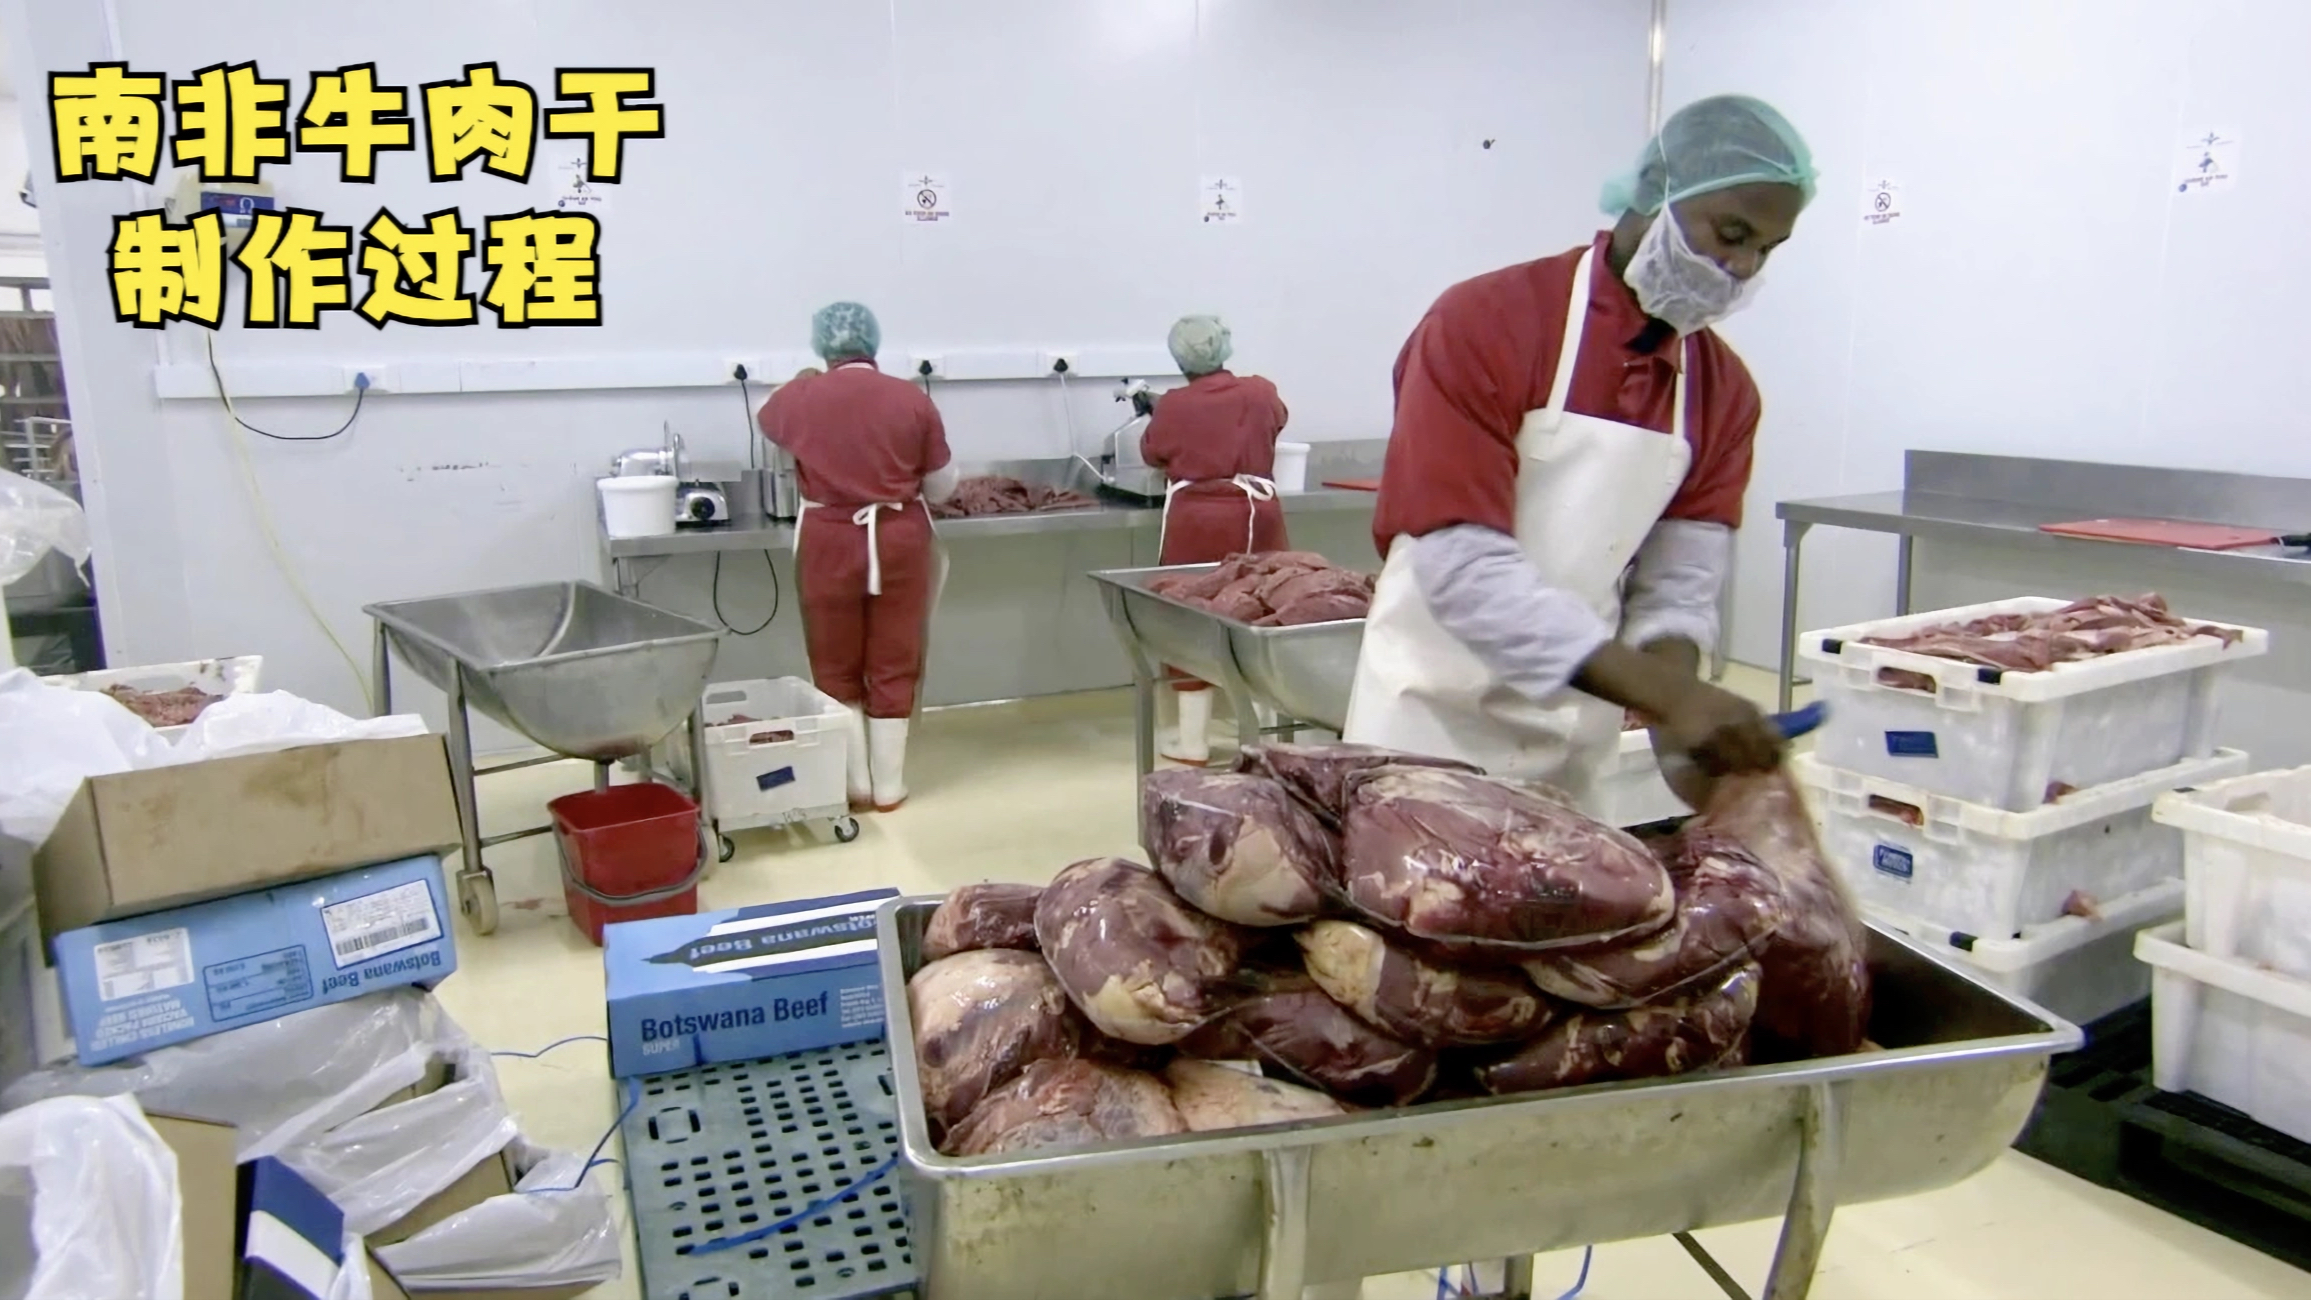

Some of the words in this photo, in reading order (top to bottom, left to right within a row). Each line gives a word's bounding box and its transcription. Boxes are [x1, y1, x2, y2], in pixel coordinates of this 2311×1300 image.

[761, 919, 877, 945] otswana
[690, 938, 752, 960] Beef
[363, 950, 441, 980] Botswana
[322, 971, 360, 995] Beef
[641, 1005, 765, 1042] Botswana
[774, 990, 828, 1022] Beef
